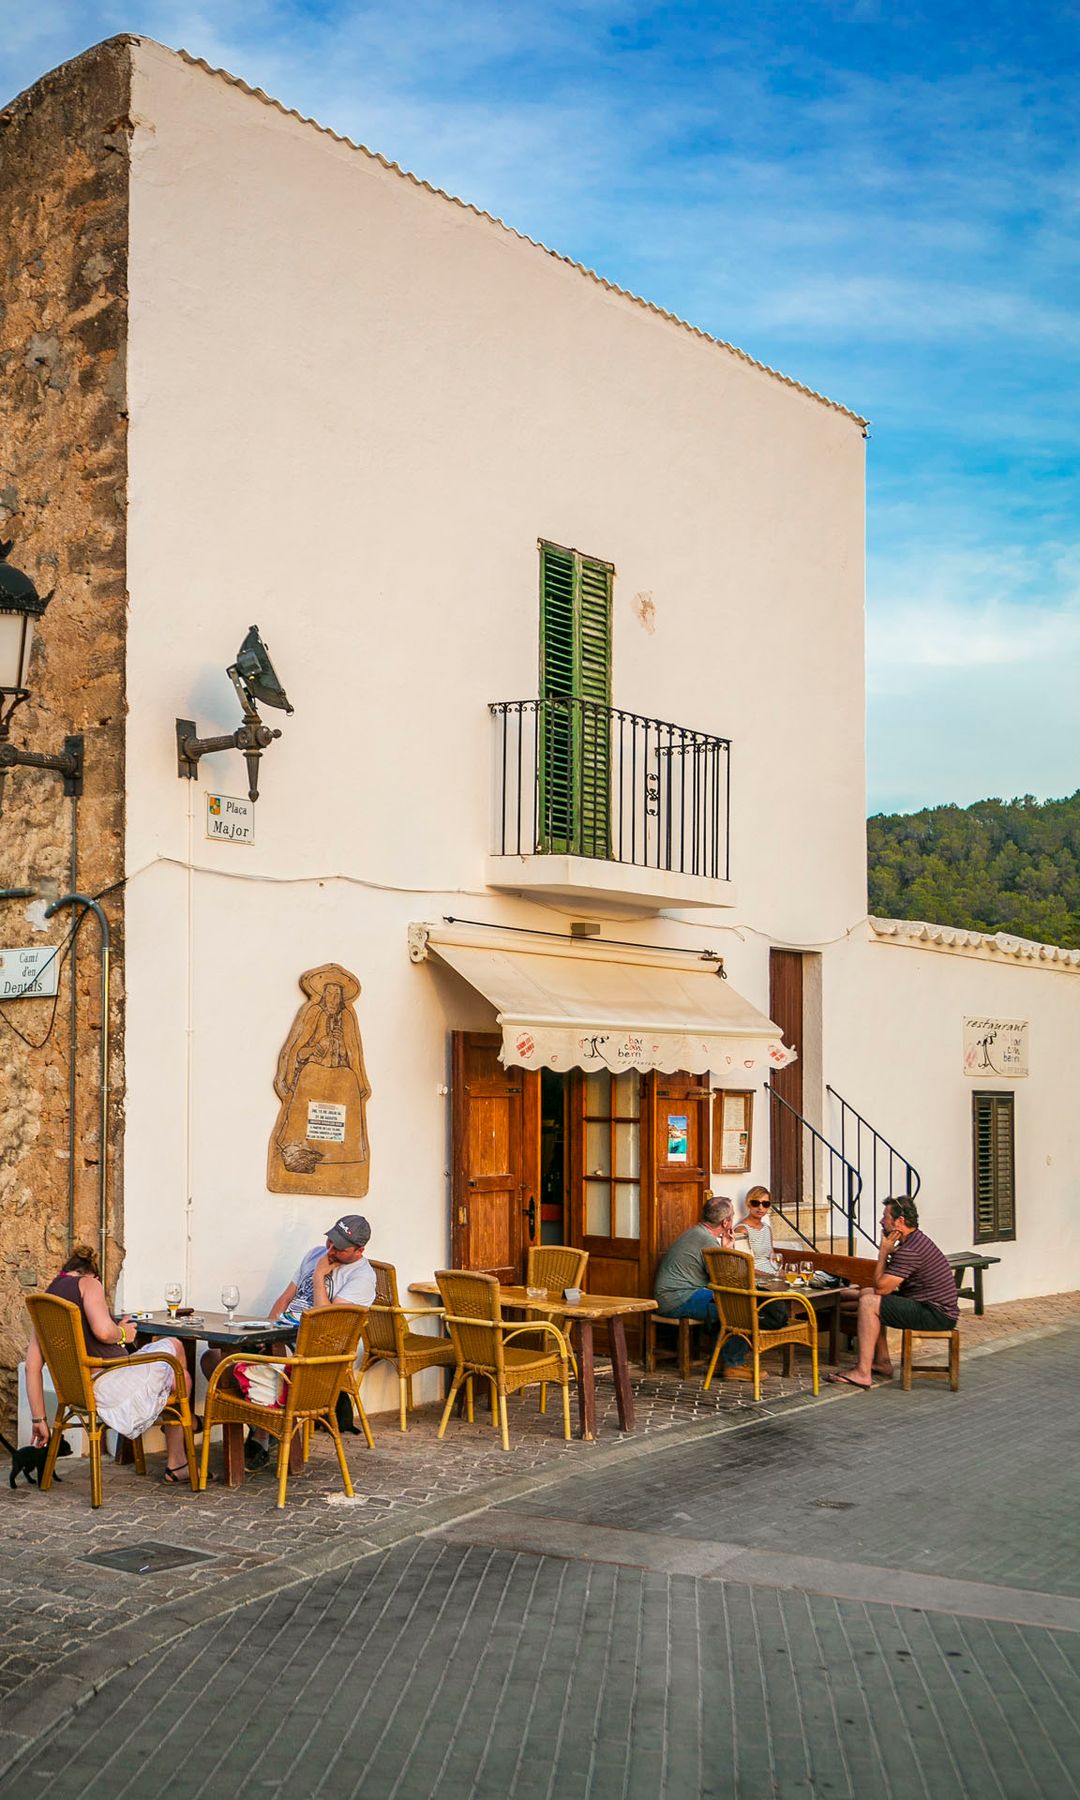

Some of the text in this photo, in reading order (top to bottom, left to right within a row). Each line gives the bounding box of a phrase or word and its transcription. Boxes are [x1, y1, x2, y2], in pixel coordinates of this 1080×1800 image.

[226, 801, 247, 815] Plaça
[213, 820, 250, 838] Major
[22, 965, 36, 977] d'en
[966, 1018, 1029, 1031] restaurant
[628, 1034, 642, 1045] bar
